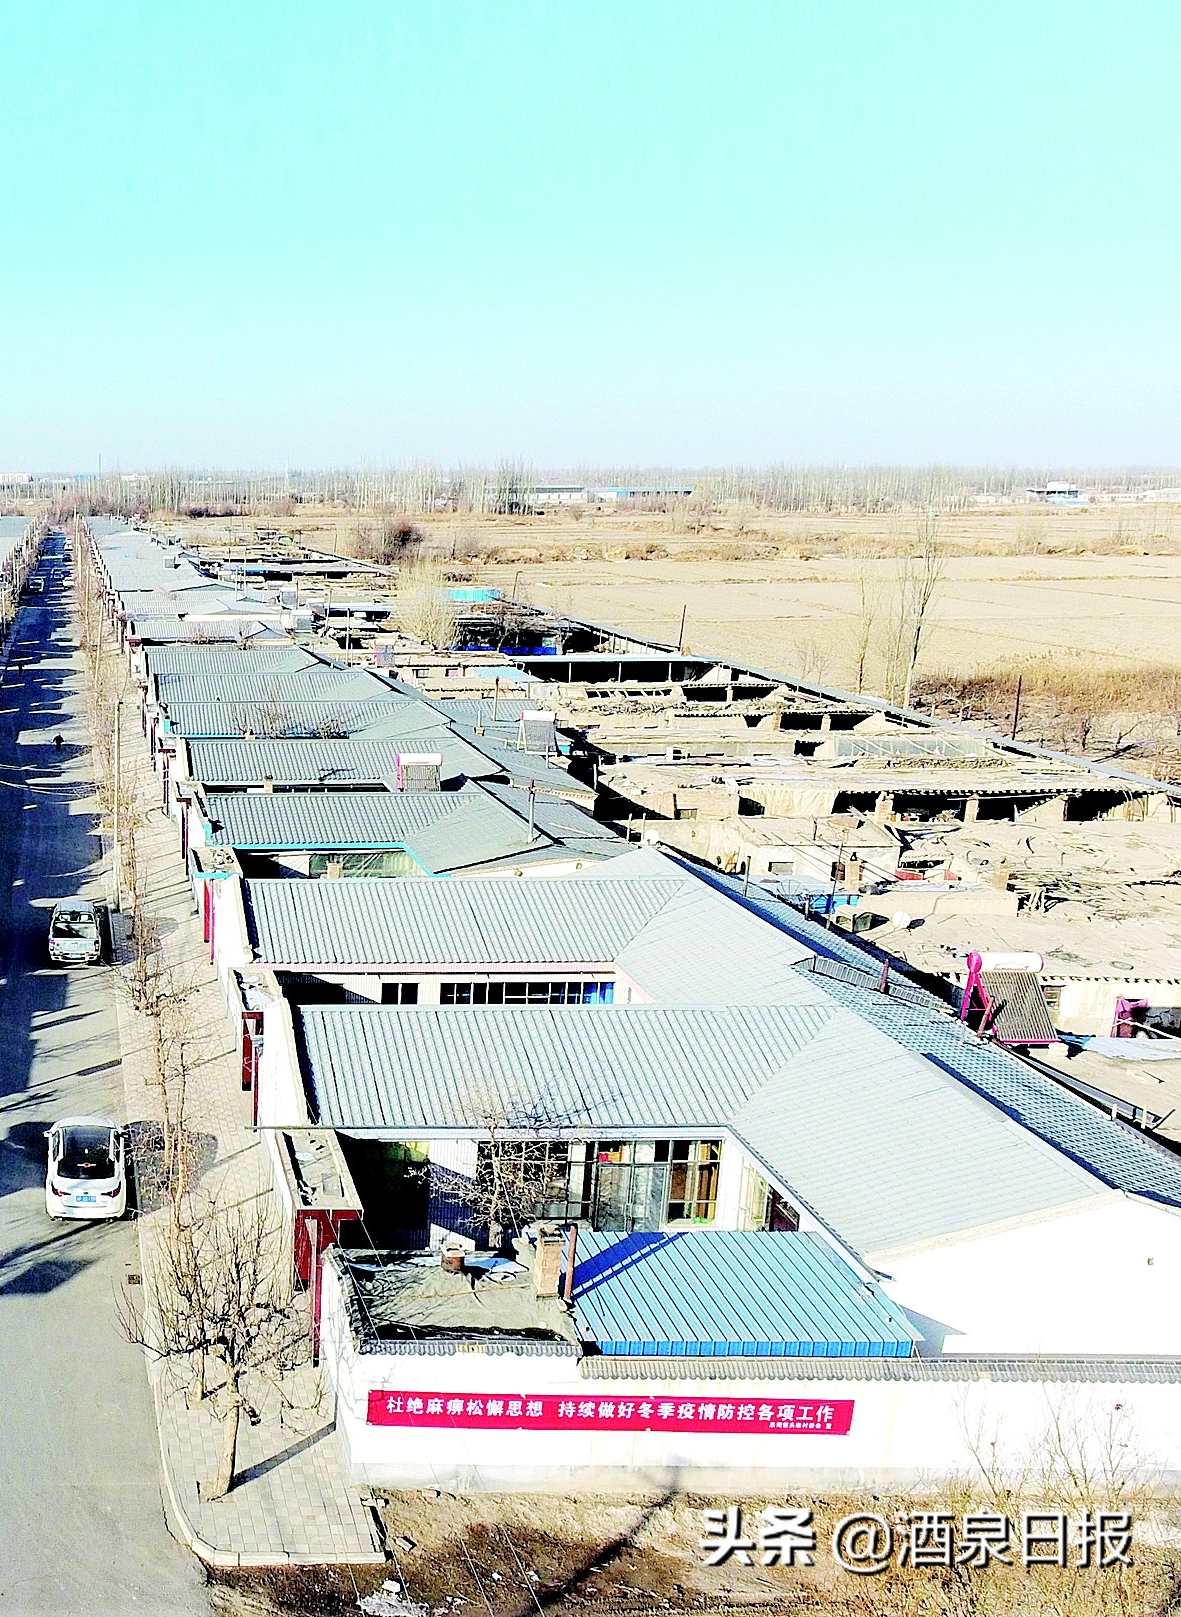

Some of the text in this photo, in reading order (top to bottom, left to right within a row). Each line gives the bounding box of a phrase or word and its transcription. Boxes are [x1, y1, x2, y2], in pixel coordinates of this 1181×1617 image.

[386, 1396, 835, 1422] 杜绝麻痹松懈思想 持续做好冬季疫情防控各项工作
